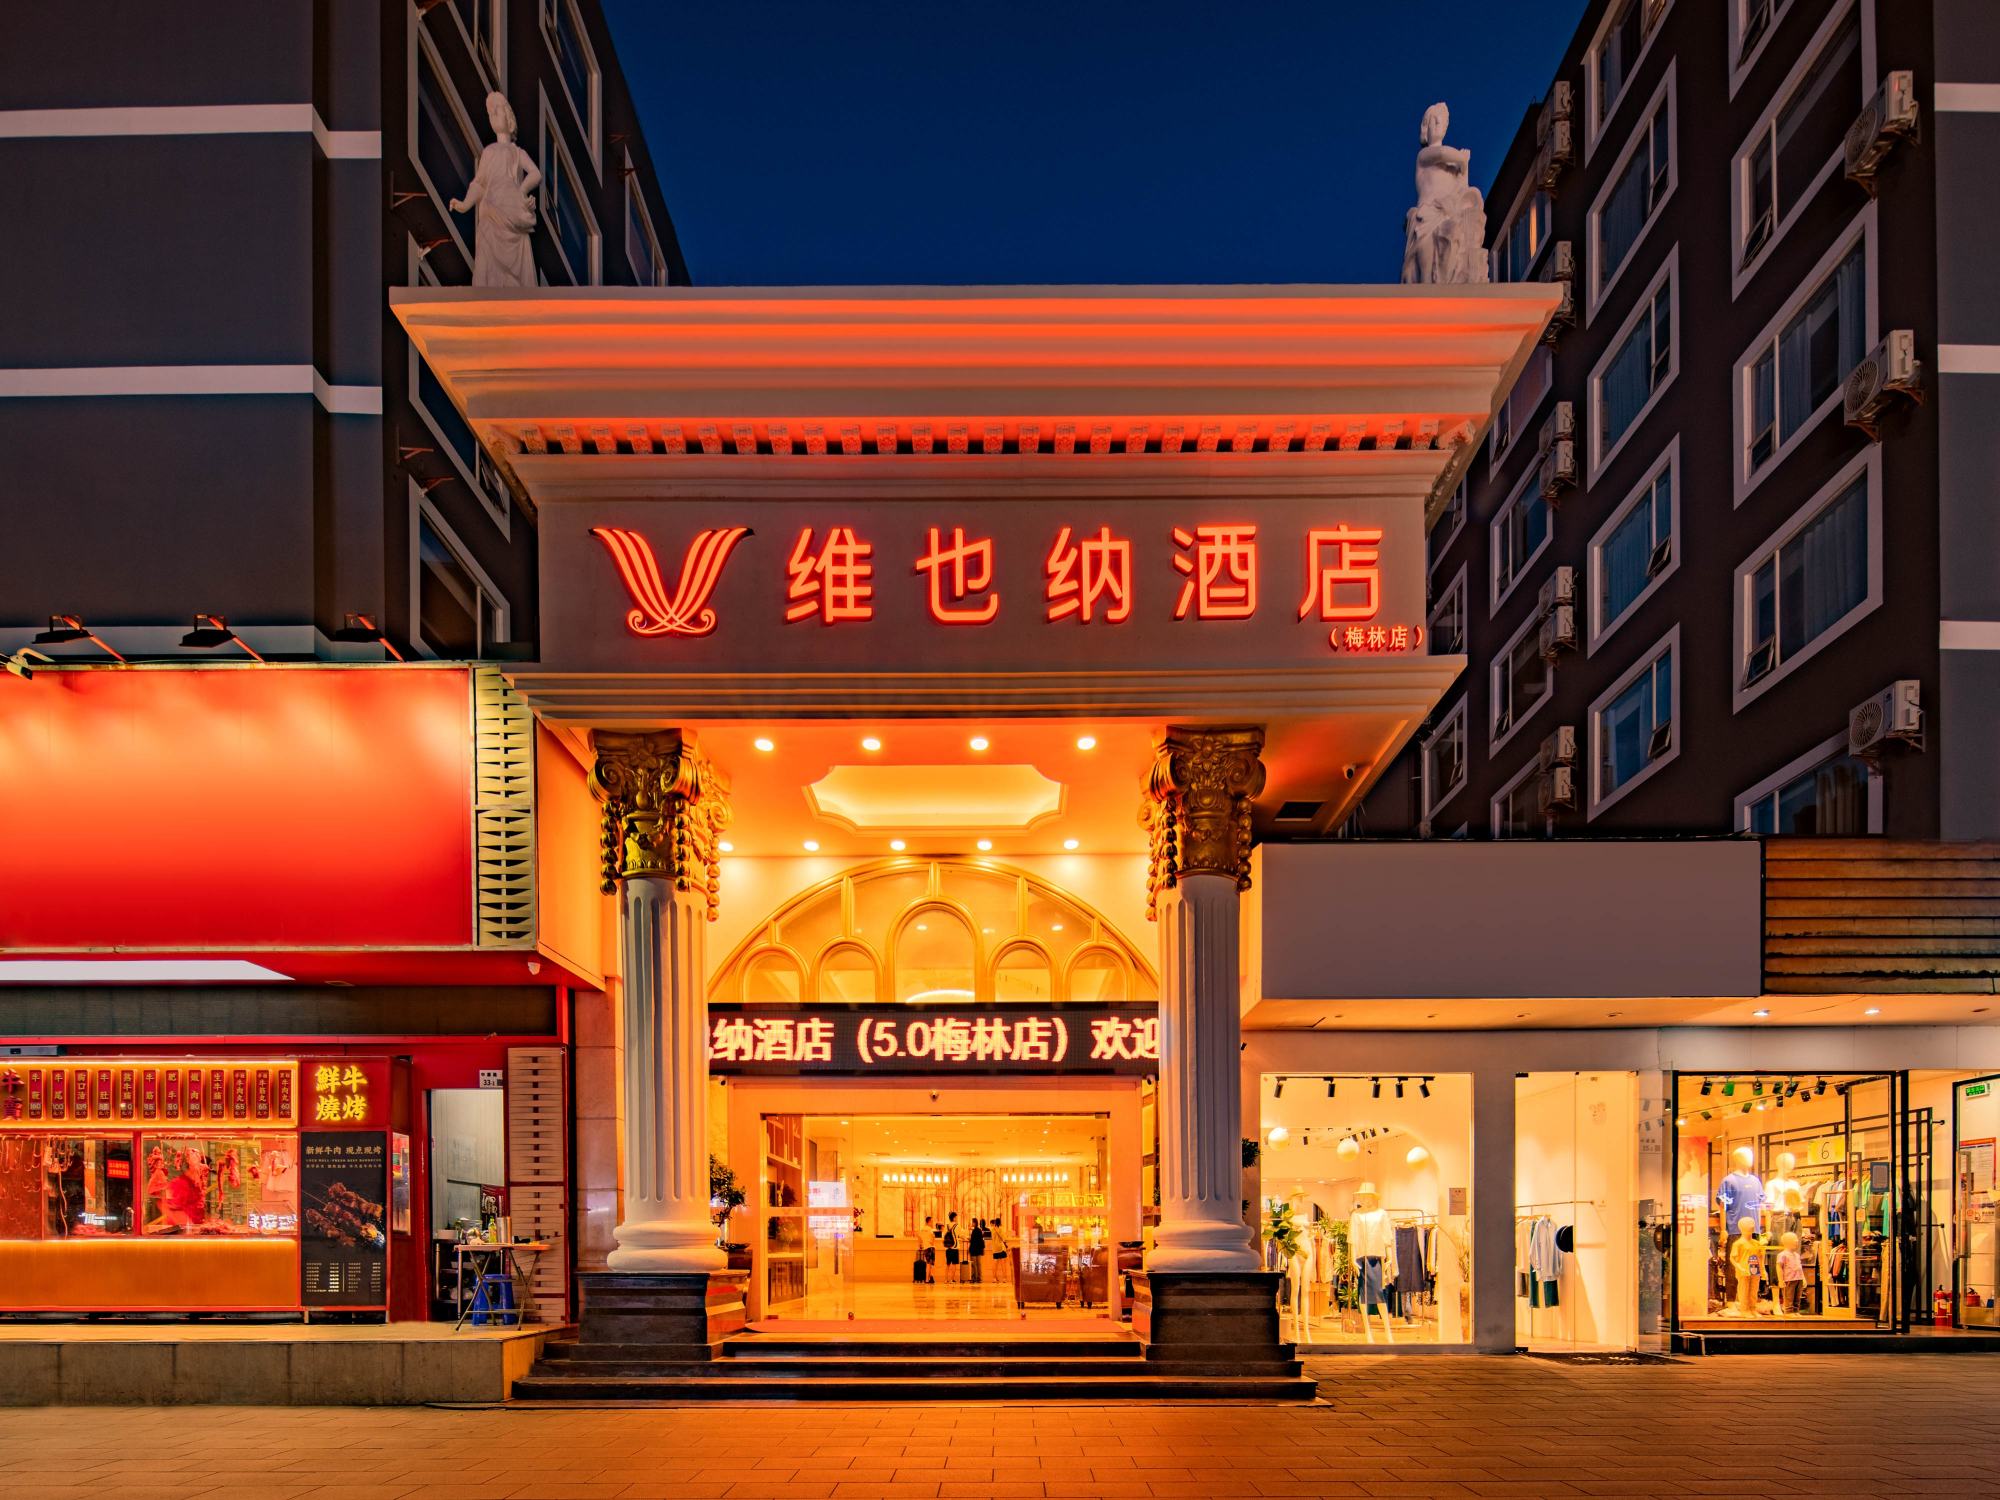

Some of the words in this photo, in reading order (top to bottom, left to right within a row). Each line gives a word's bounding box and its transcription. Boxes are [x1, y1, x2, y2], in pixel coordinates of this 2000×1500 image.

[785, 523, 1385, 624] 维也纳酒店
[709, 1016, 834, 1061] 纳酒店
